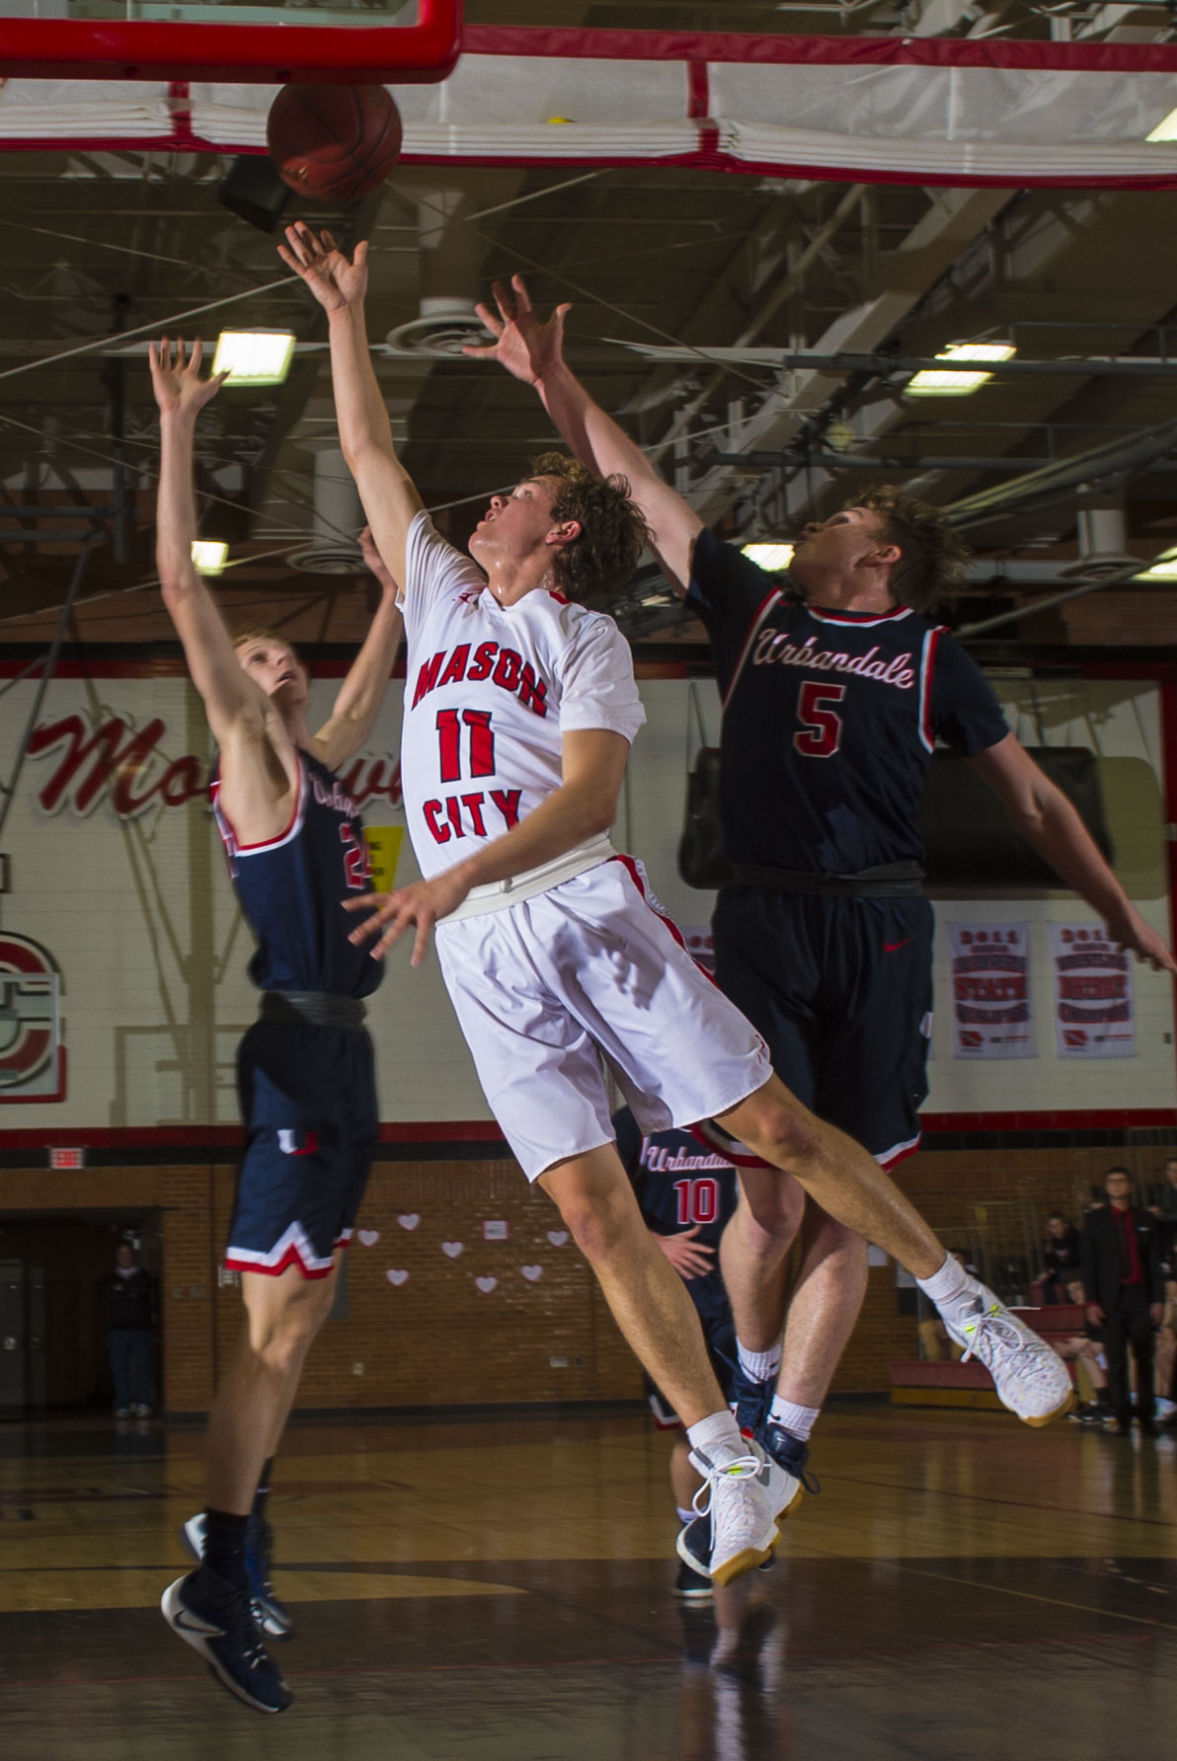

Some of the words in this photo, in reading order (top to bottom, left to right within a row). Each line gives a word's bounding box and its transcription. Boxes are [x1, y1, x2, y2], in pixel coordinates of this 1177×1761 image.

[411, 641, 547, 719] MASON
[753, 628, 915, 690] Urbandale
[435, 708, 496, 784] 11
[793, 680, 847, 758] 5
[422, 789, 523, 844] CITY
[673, 1177, 719, 1225] 10
